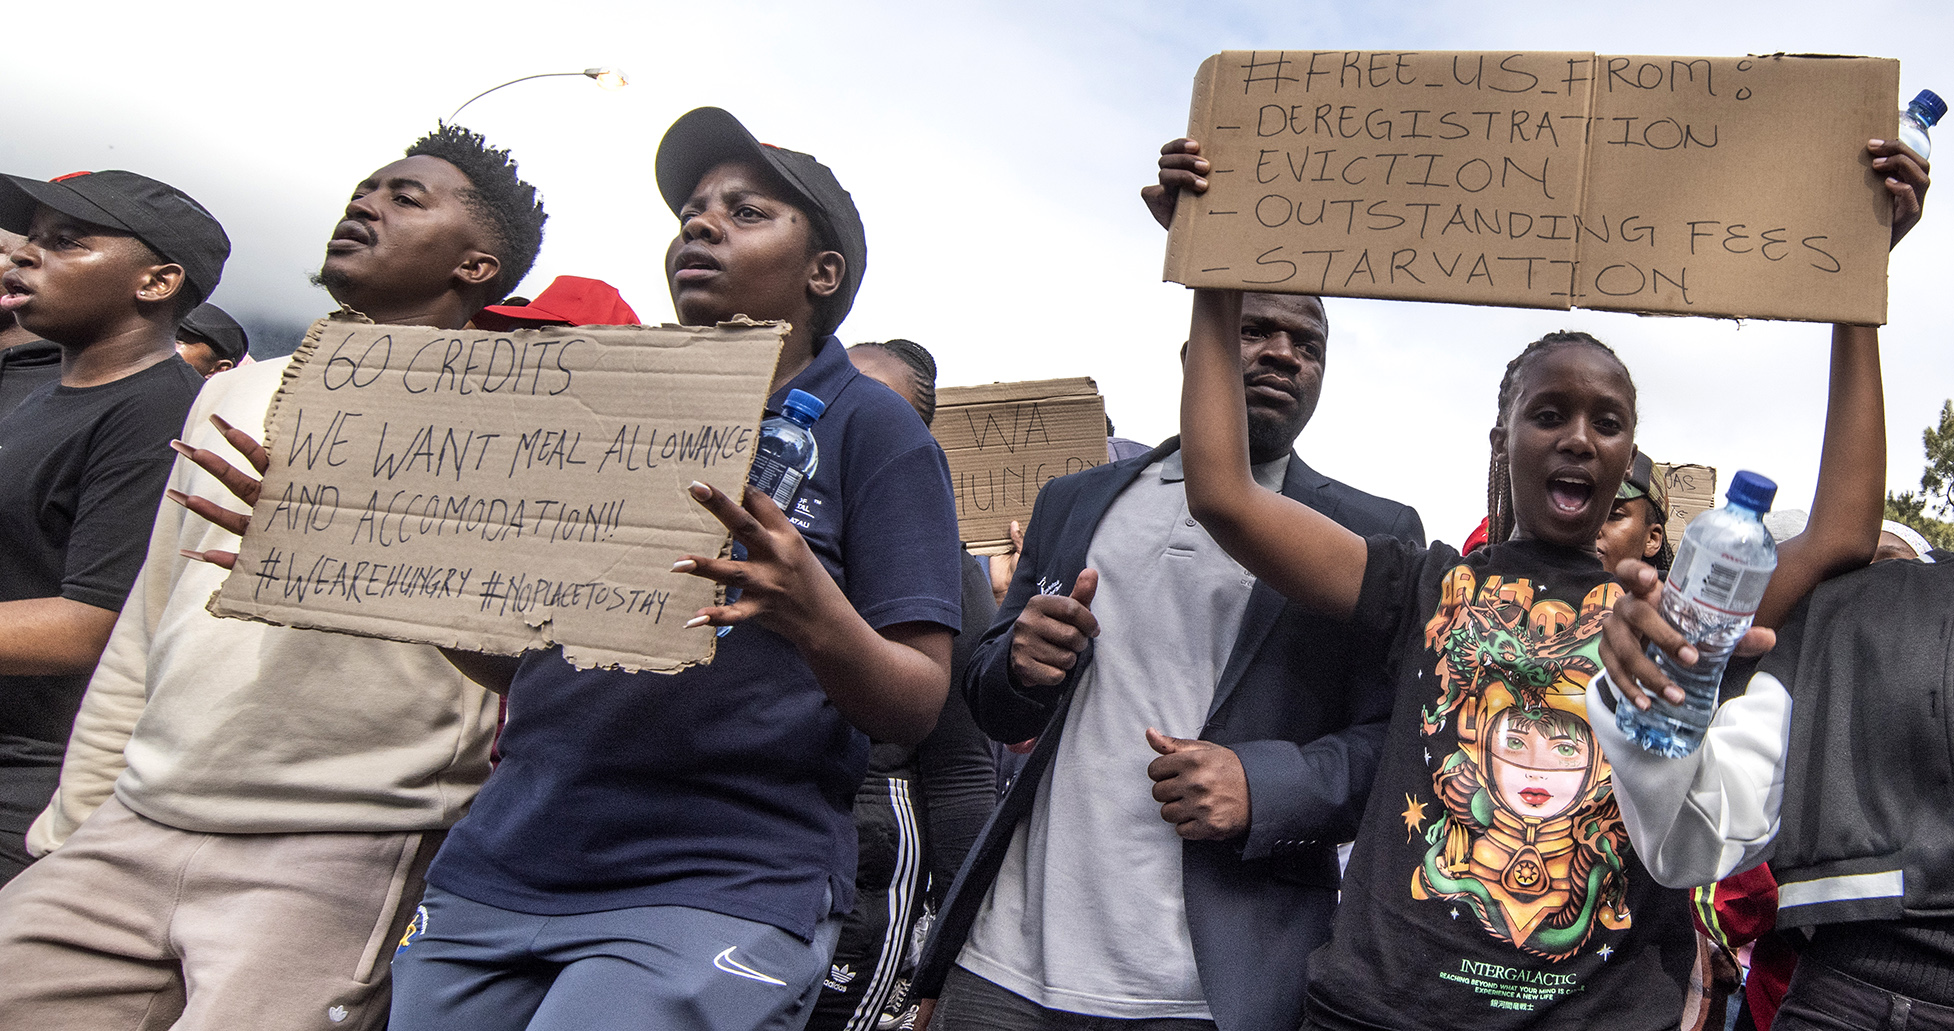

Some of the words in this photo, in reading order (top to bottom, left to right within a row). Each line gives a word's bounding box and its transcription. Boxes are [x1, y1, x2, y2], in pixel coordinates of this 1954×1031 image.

[1257, 104, 1718, 150] DEREGISTRATION
[1257, 146, 1555, 200] EVICTION
[1255, 194, 1655, 247] OUTSTANDING
[1686, 220, 1841, 273] FEES
[1242, 246, 1693, 305] STARVATION
[324, 332, 392, 391] 60
[403, 338, 585, 396] CREDITS
[288, 408, 363, 470] WE
[373, 422, 500, 481] WANT
[508, 428, 586, 479] MEAL
[597, 425, 752, 473] ALLOWANCE
[965, 402, 1050, 454] WA
[955, 456, 1100, 515] UNG
[264, 481, 339, 535] AND
[352, 489, 625, 547] ACCOMODATION!!
[256, 546, 472, 604] #WEAREHUNGRY
[480, 571, 670, 624] #NOPLACETOSTAY
[823, 979, 848, 993] adidas
[1439, 971, 1470, 985] REACHING
[1471, 978, 1498, 989] BEYOND
[1500, 984, 1518, 992] WHAT
[1520, 985, 1538, 995] YOUR
[1460, 958, 1577, 986] INTERGALACTIC
[1475, 986, 1515, 998] EXPERIENCE
